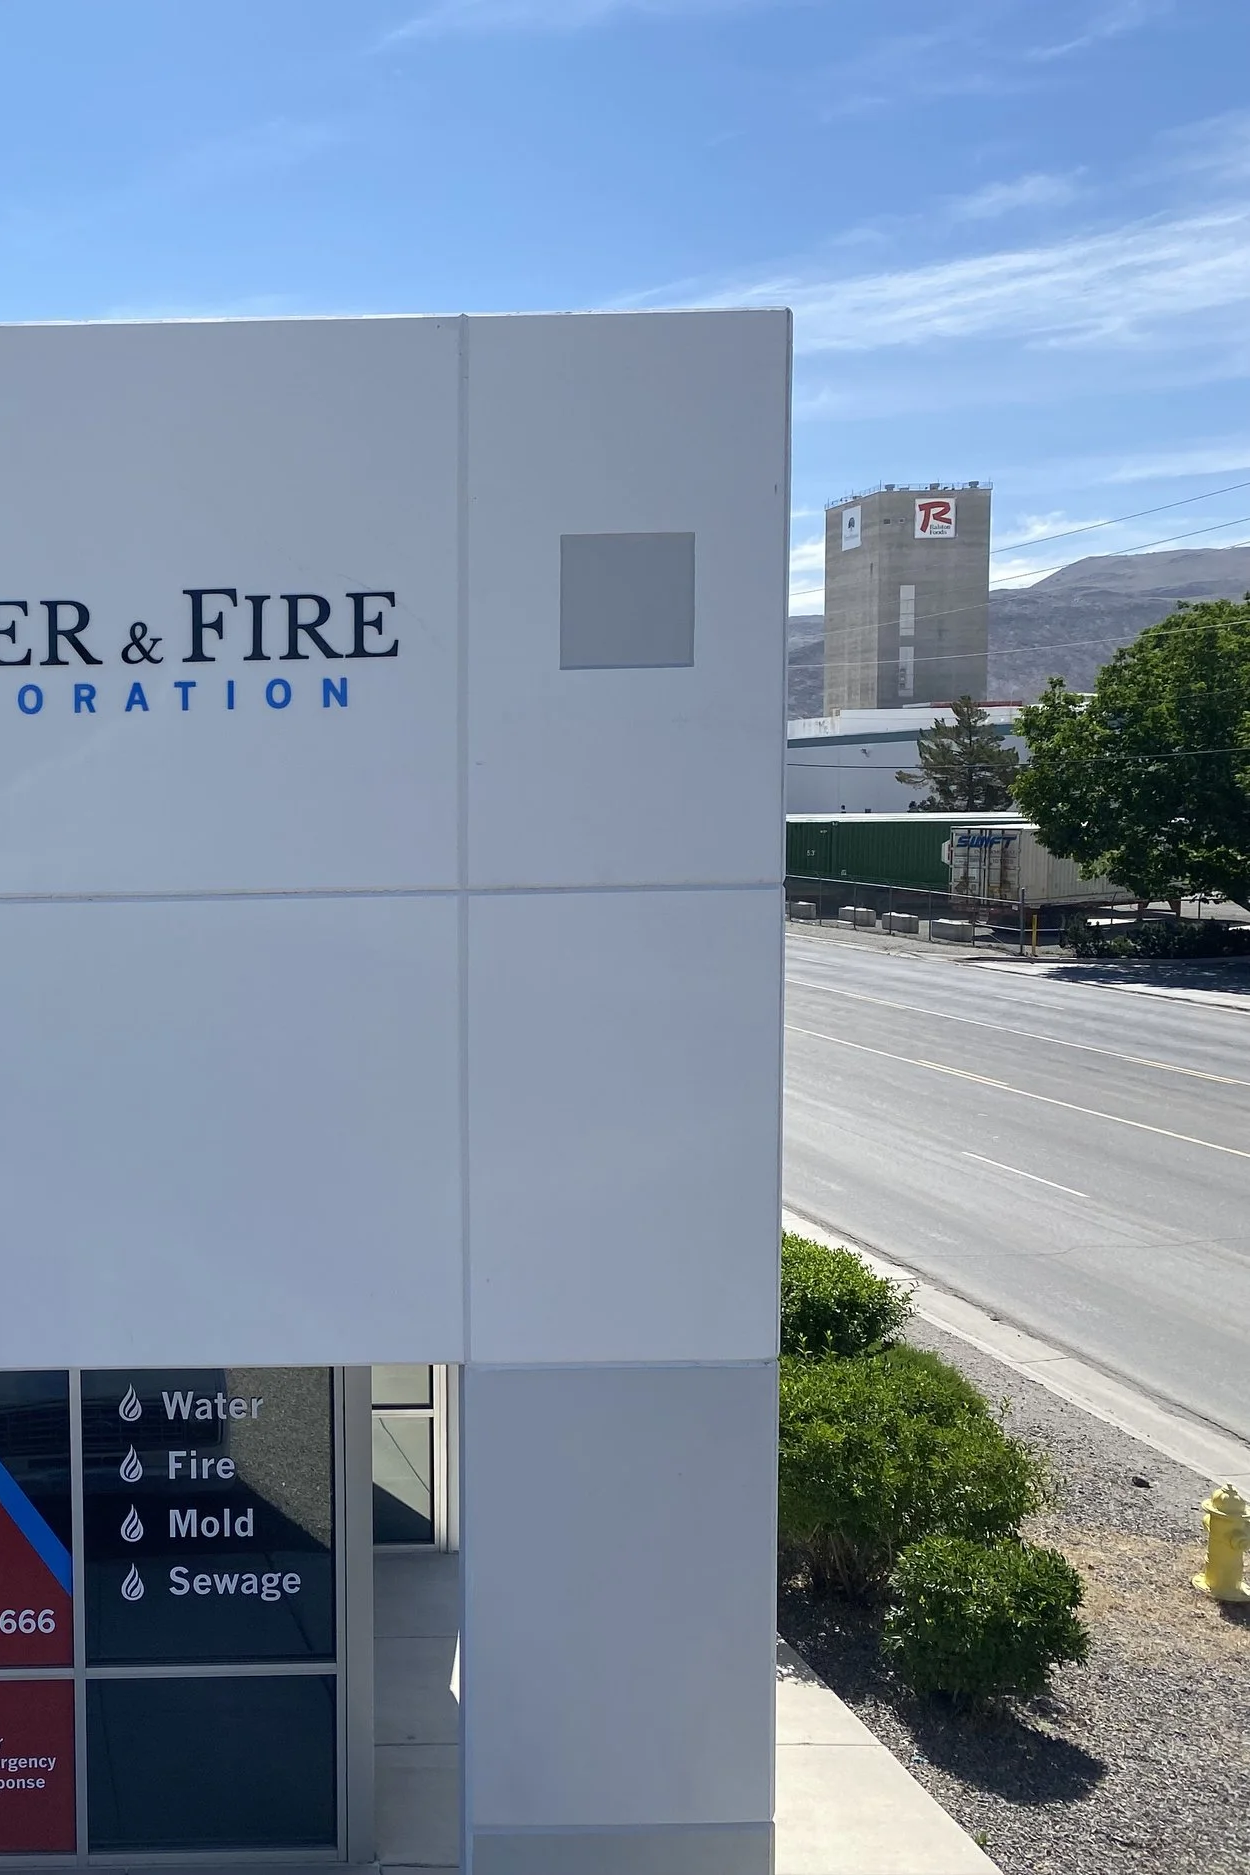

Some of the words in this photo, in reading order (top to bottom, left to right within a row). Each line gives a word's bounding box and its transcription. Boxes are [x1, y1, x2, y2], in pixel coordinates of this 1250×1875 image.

[120, 621, 164, 665] &
[182, 588, 401, 662] FIRE
[956, 834, 1018, 849] SWIFT
[161, 1391, 264, 1420] Water
[167, 1451, 236, 1480] Fire
[169, 1508, 255, 1538] Mold
[168, 1566, 302, 1603] Sewage
